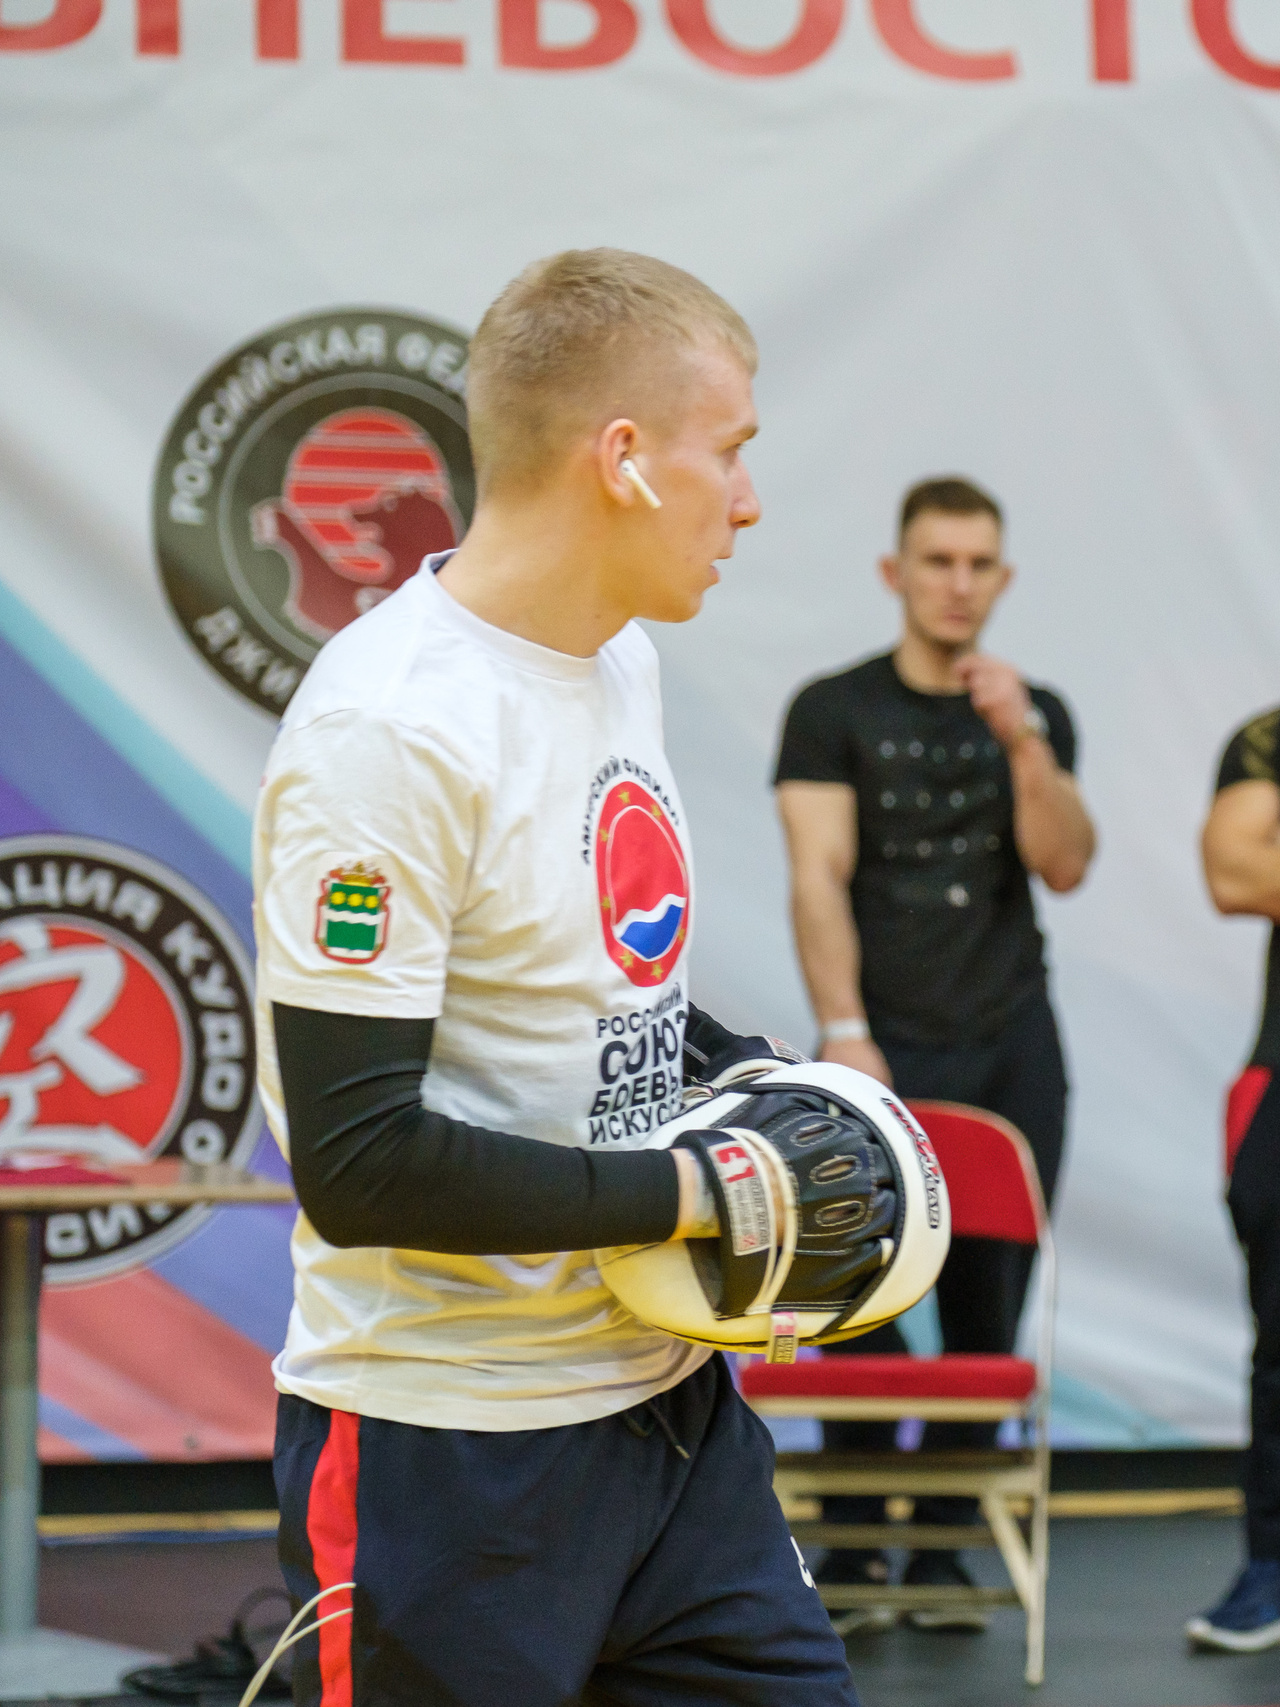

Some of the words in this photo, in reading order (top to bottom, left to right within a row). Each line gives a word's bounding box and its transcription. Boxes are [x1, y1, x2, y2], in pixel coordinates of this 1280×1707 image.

[168, 323, 388, 526] РОССИЙСКАЯ
[0, 862, 163, 933] ЦИЯ
[161, 921, 247, 1112] КУДО
